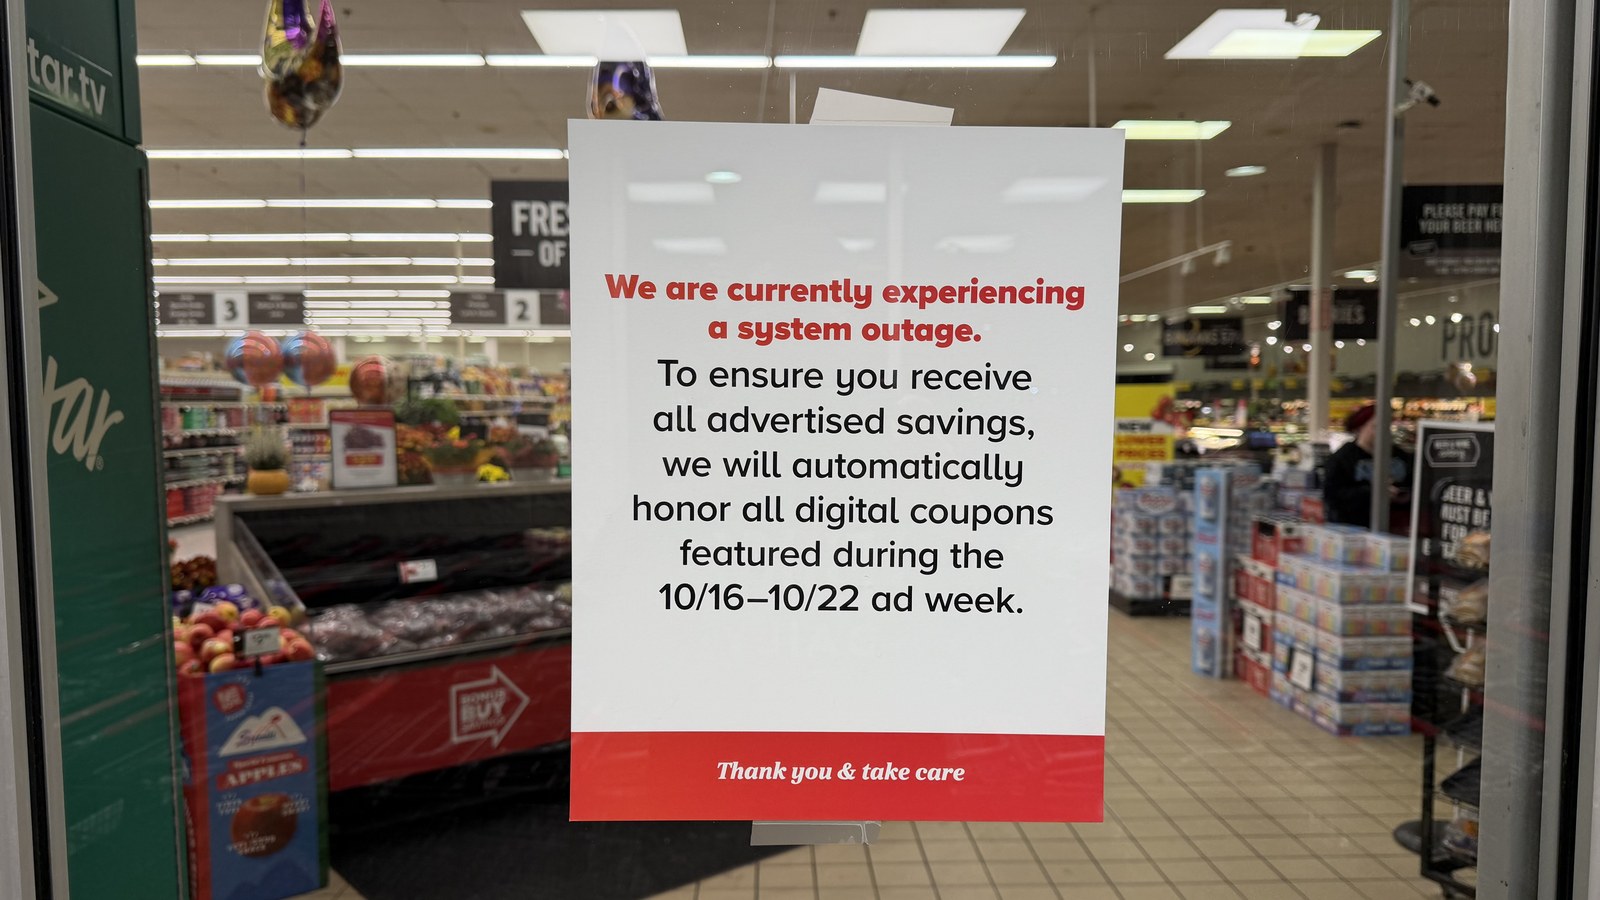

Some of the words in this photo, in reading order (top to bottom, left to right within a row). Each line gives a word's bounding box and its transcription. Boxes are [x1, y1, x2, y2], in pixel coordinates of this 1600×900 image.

[511, 200, 569, 237] FRE
[1423, 203, 1465, 219] PLEASE
[1467, 203, 1490, 219] PAY
[1419, 219, 1450, 234] YOUR
[1452, 219, 1482, 234] BEER
[538, 240, 567, 267] OF
[605, 274, 657, 301] We
[665, 281, 718, 301] are
[727, 278, 874, 311] currently
[882, 277, 1086, 311] experiencing
[224, 301, 237, 320] 3
[516, 301, 528, 320] 2
[708, 320, 728, 339] a
[738, 317, 852, 347] system
[861, 319, 982, 349] outage.
[657, 359, 697, 389] To
[709, 366, 824, 389] ensure
[836, 368, 898, 396] you
[911, 361, 1032, 391] receive
[653, 404, 697, 433] all
[707, 405, 885, 435] advertised
[896, 406, 1035, 444] savings,
[1118, 422, 1152, 431] NEW
[1117, 435, 1165, 446] LOWER
[1117, 449, 1167, 460] PRICES
[662, 456, 712, 479] we
[722, 449, 782, 479] will
[792, 450, 1023, 488] automatically
[633, 494, 732, 523] honor
[742, 495, 785, 523] all
[795, 495, 900, 532] digital
[910, 503, 1054, 533] coupons
[679, 538, 821, 568] featured
[833, 540, 938, 576] during
[949, 541, 1004, 570] the
[658, 582, 859, 612] 10/16–10/22
[871, 585, 913, 613] ad
[924, 586, 1024, 614] week.
[461, 702, 504, 721] BUY
[226, 762, 303, 786] APPLES
[717, 761, 788, 781] Thank
[790, 766, 833, 785] you
[836, 762, 857, 781] &
[861, 761, 911, 781] take
[915, 767, 966, 782] care
